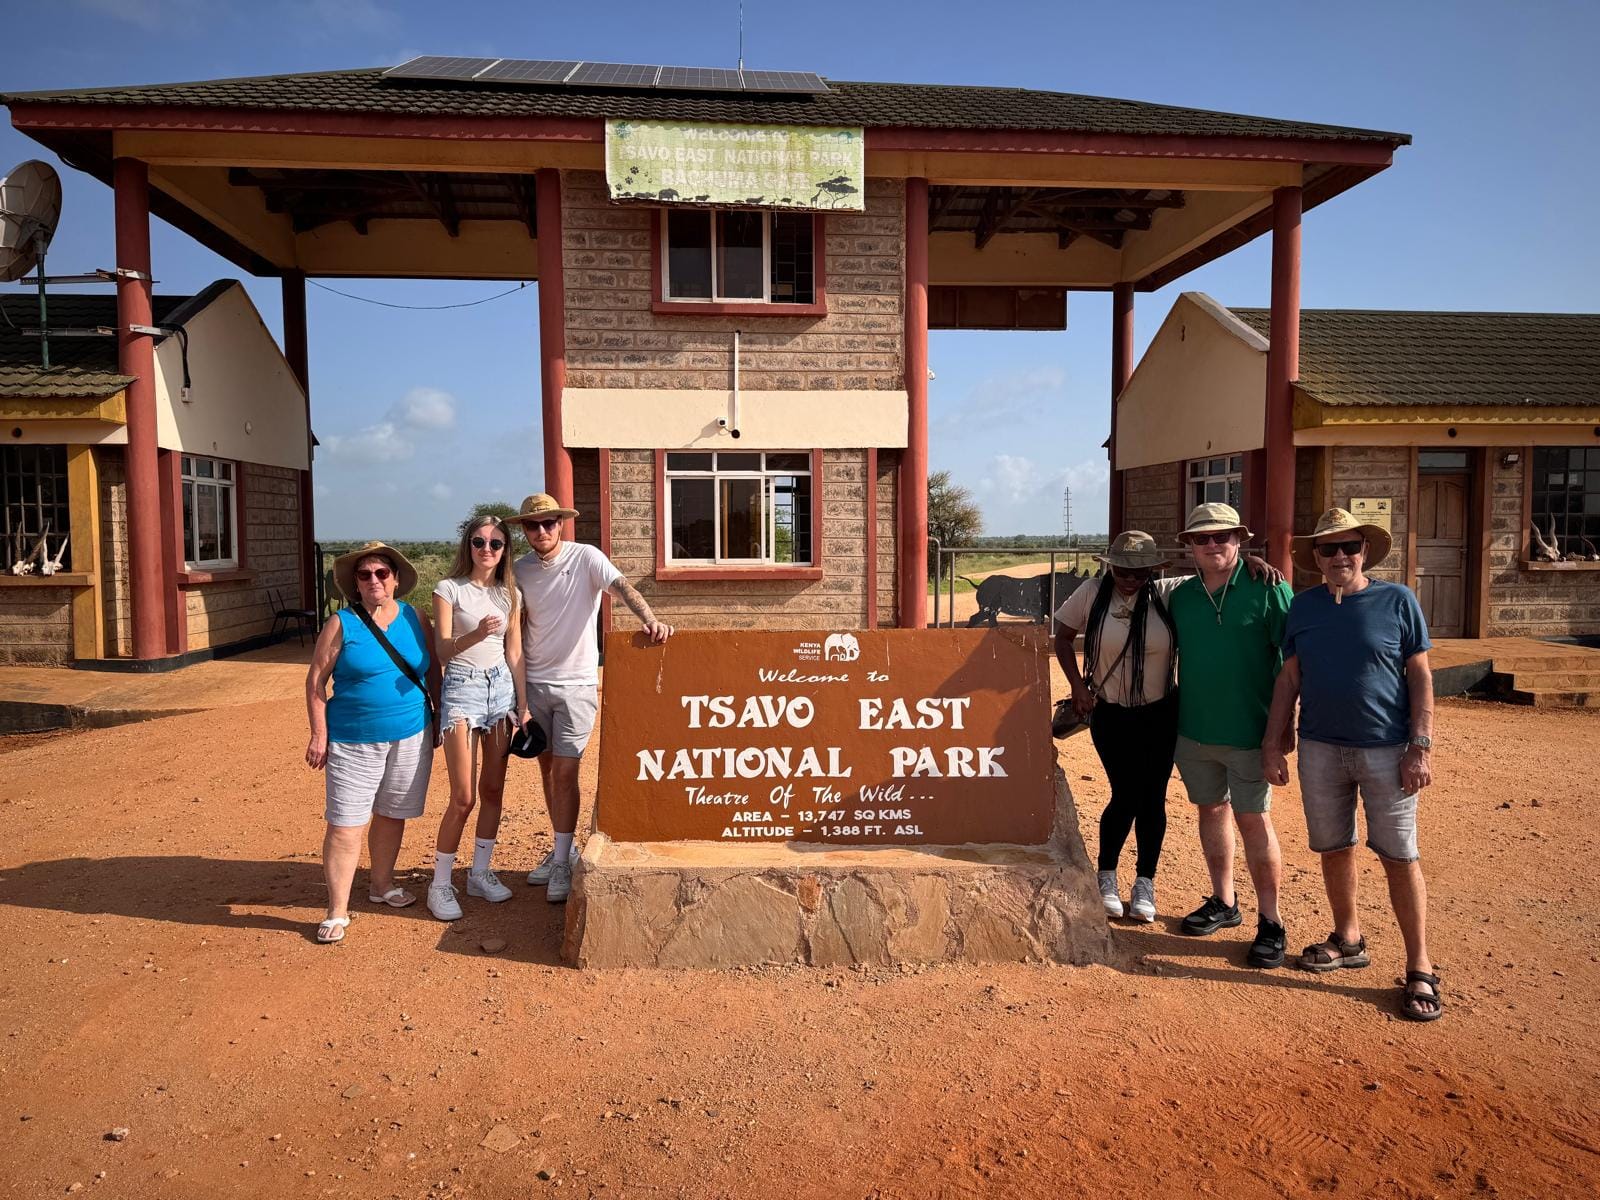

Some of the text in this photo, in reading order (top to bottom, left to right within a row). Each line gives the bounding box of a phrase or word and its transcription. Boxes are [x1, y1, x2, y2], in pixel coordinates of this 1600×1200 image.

[683, 128, 767, 142] WELCOME
[675, 147, 716, 163] EAST
[811, 151, 853, 168] PARK
[758, 667, 889, 683] Welcome to
[681, 695, 971, 730] TSAVO EAST
[636, 746, 1009, 782] NATIONAL PARK
[684, 786, 750, 805] Theatre
[769, 783, 795, 807] Of
[812, 784, 842, 804] The
[732, 811, 773, 822] AREA
[797, 810, 846, 824] 13,747
[854, 809, 876, 821] SQ
[878, 809, 912, 820] KMS
[721, 826, 794, 837] ALTITUDE
[820, 825, 861, 837] 1,388
[864, 825, 886, 836] FT.
[894, 824, 924, 835] ASL
